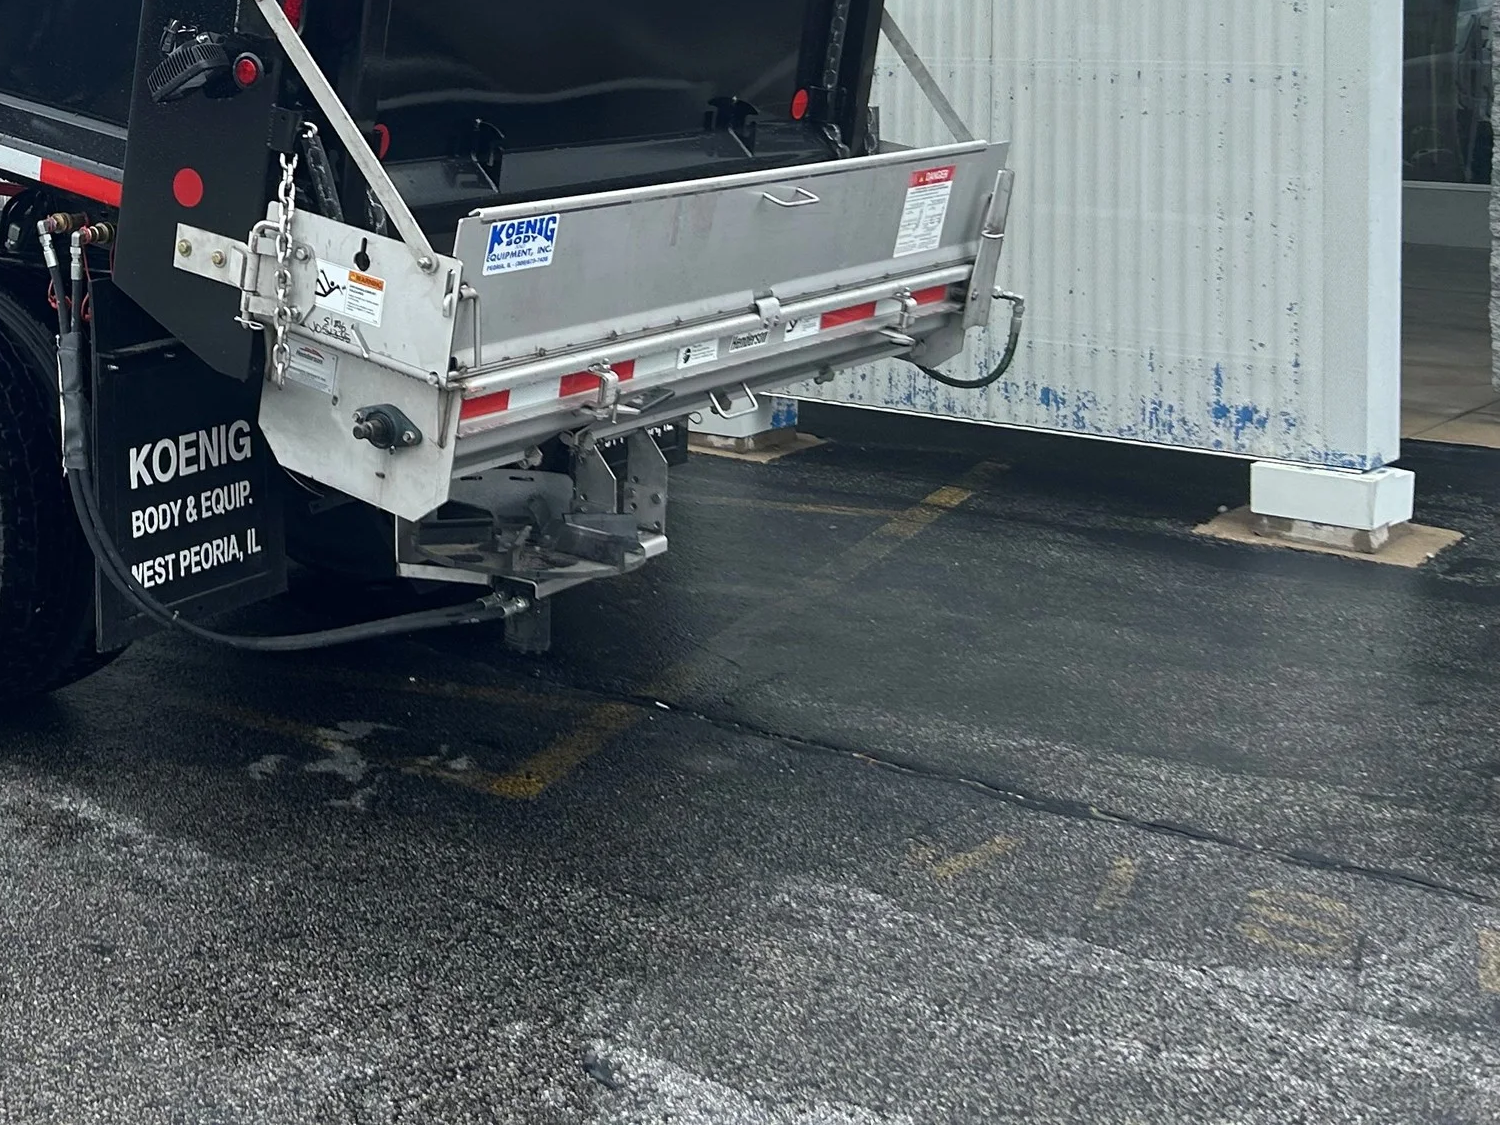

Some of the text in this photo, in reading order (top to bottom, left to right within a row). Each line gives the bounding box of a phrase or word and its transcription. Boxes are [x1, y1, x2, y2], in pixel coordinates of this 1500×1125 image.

[926, 169, 949, 182] DANGER
[488, 216, 557, 255] KOENIG
[505, 234, 539, 247] BODY
[486, 248, 534, 263] EQUIPMENT,
[129, 419, 252, 490] KOENIG
[131, 480, 253, 539] BODY & EQUIP.
[180, 534, 244, 577] PEORIA,
[247, 527, 261, 555] IL
